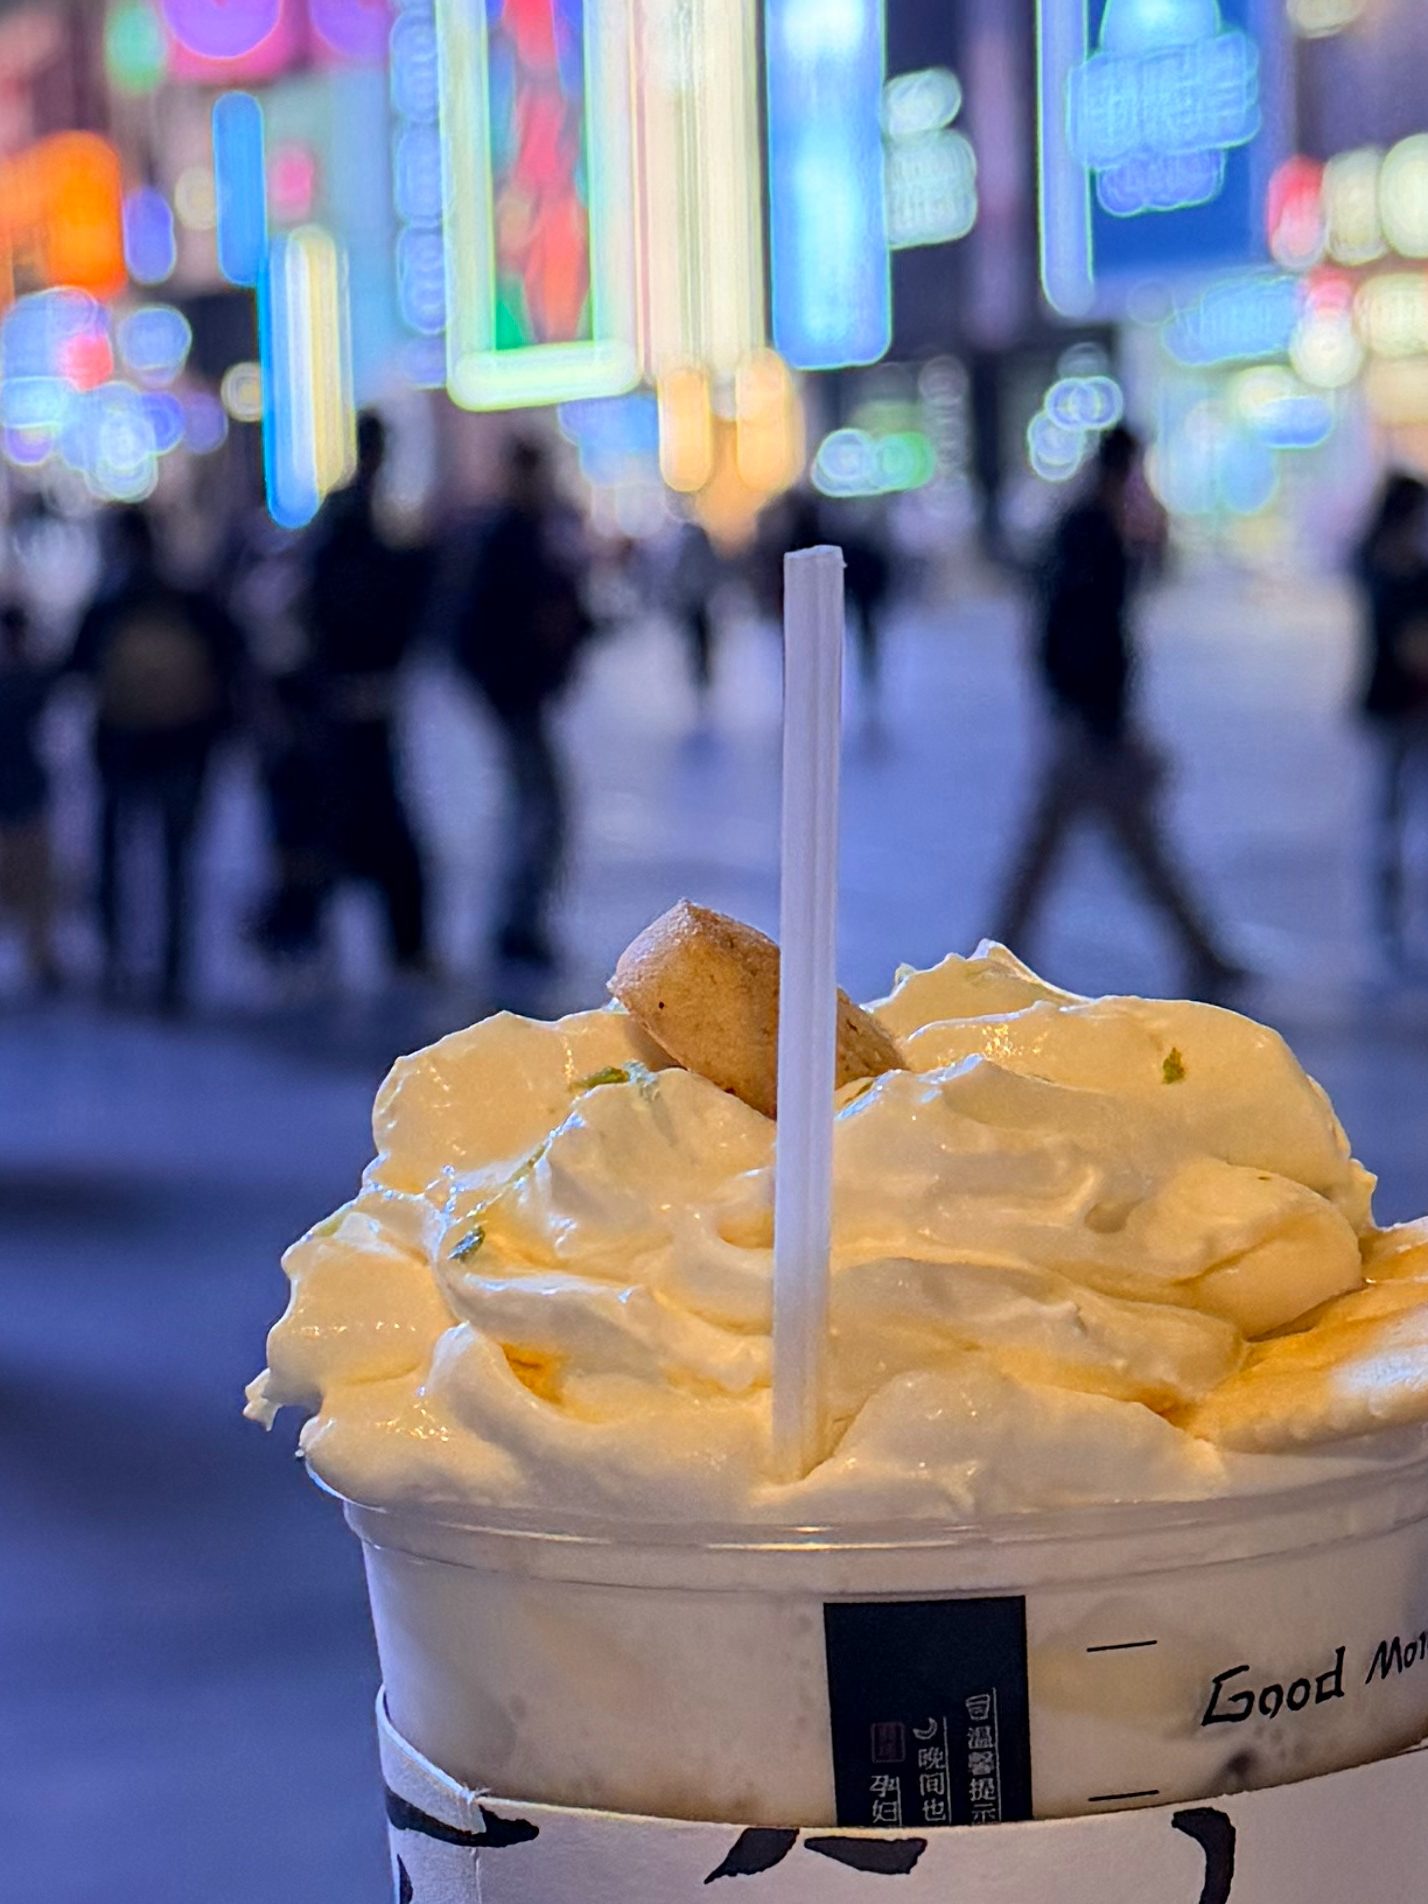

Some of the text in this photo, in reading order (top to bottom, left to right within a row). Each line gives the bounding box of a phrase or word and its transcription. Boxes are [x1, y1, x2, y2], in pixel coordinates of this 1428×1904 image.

[1201, 1646, 1346, 1726] Good
[870, 1774, 898, 1824] 孕妇
[918, 1746, 947, 1823] 晚间也
